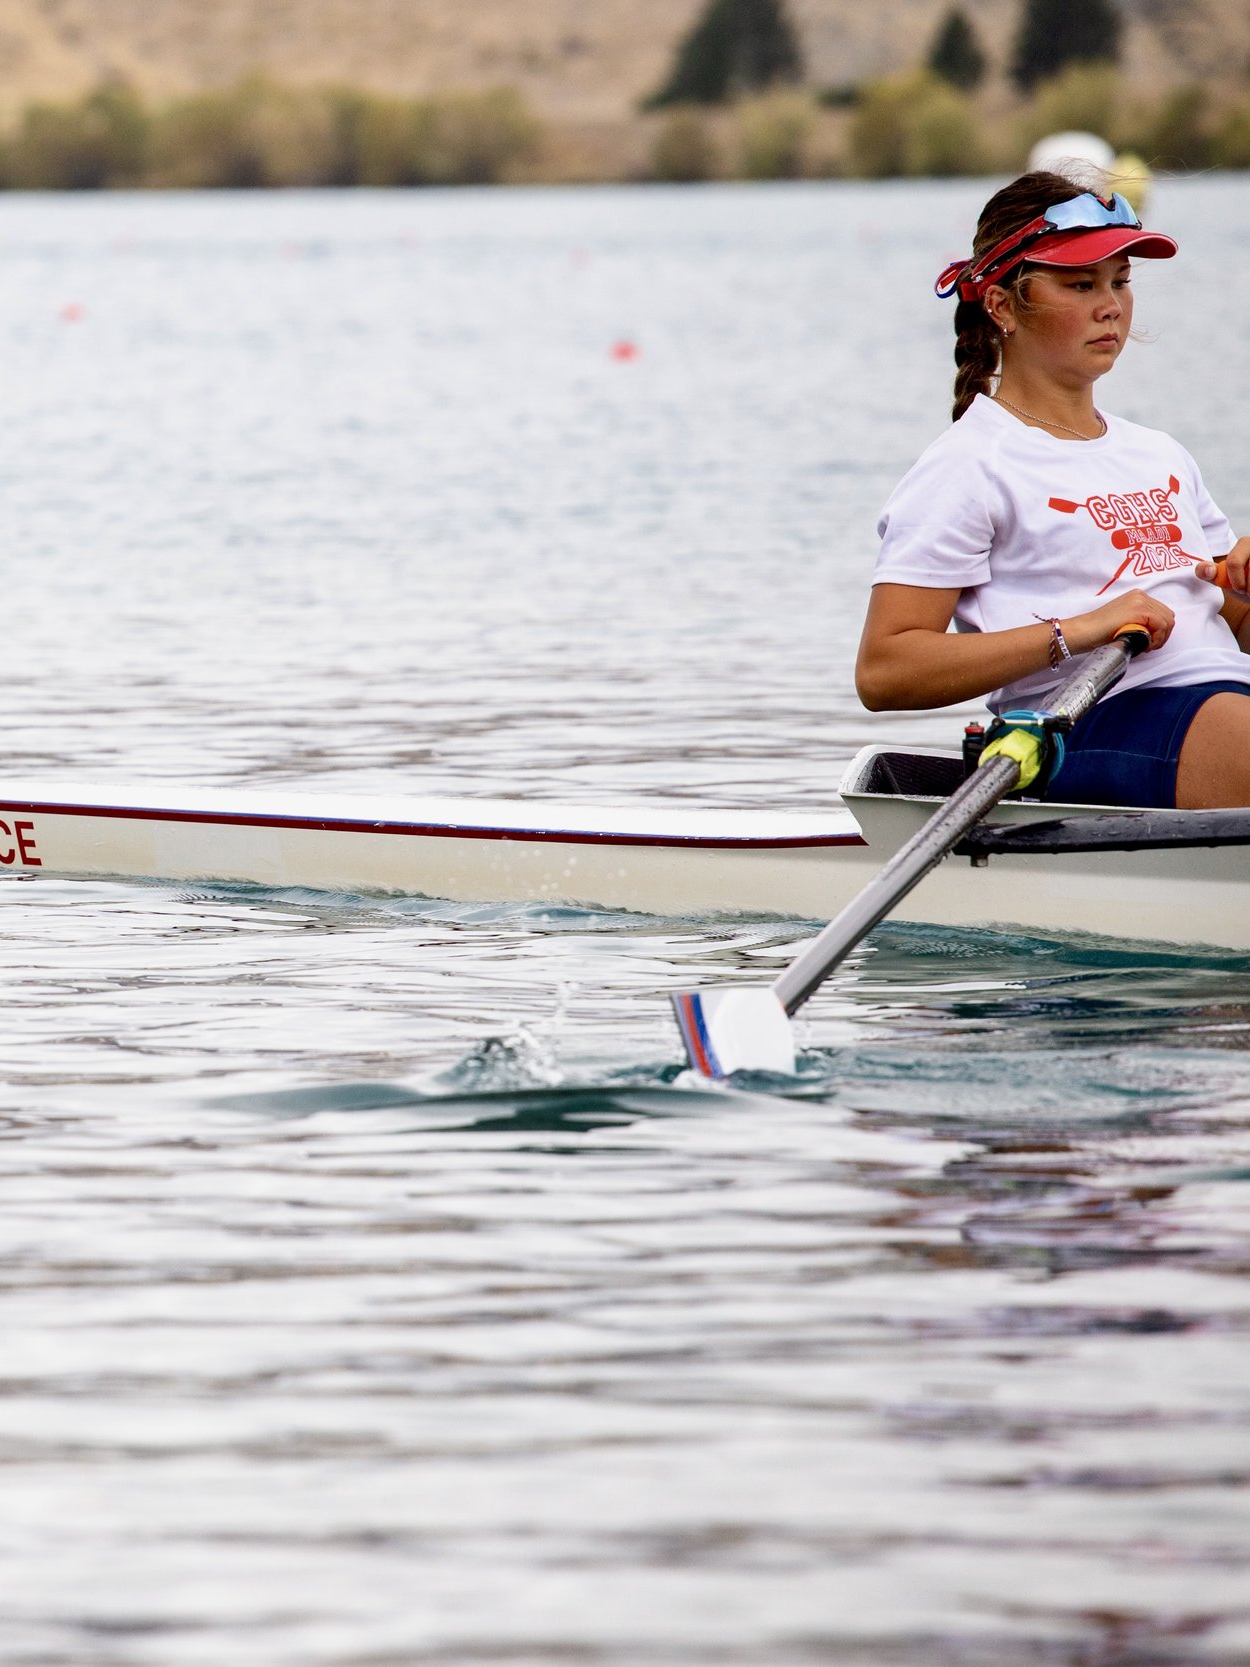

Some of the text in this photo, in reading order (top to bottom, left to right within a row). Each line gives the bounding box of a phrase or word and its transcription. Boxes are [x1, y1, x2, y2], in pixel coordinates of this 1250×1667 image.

[1086, 488, 1178, 531] CGHS
[1125, 526, 1171, 544] MAADI
[1126, 544, 1193, 577] 2026
